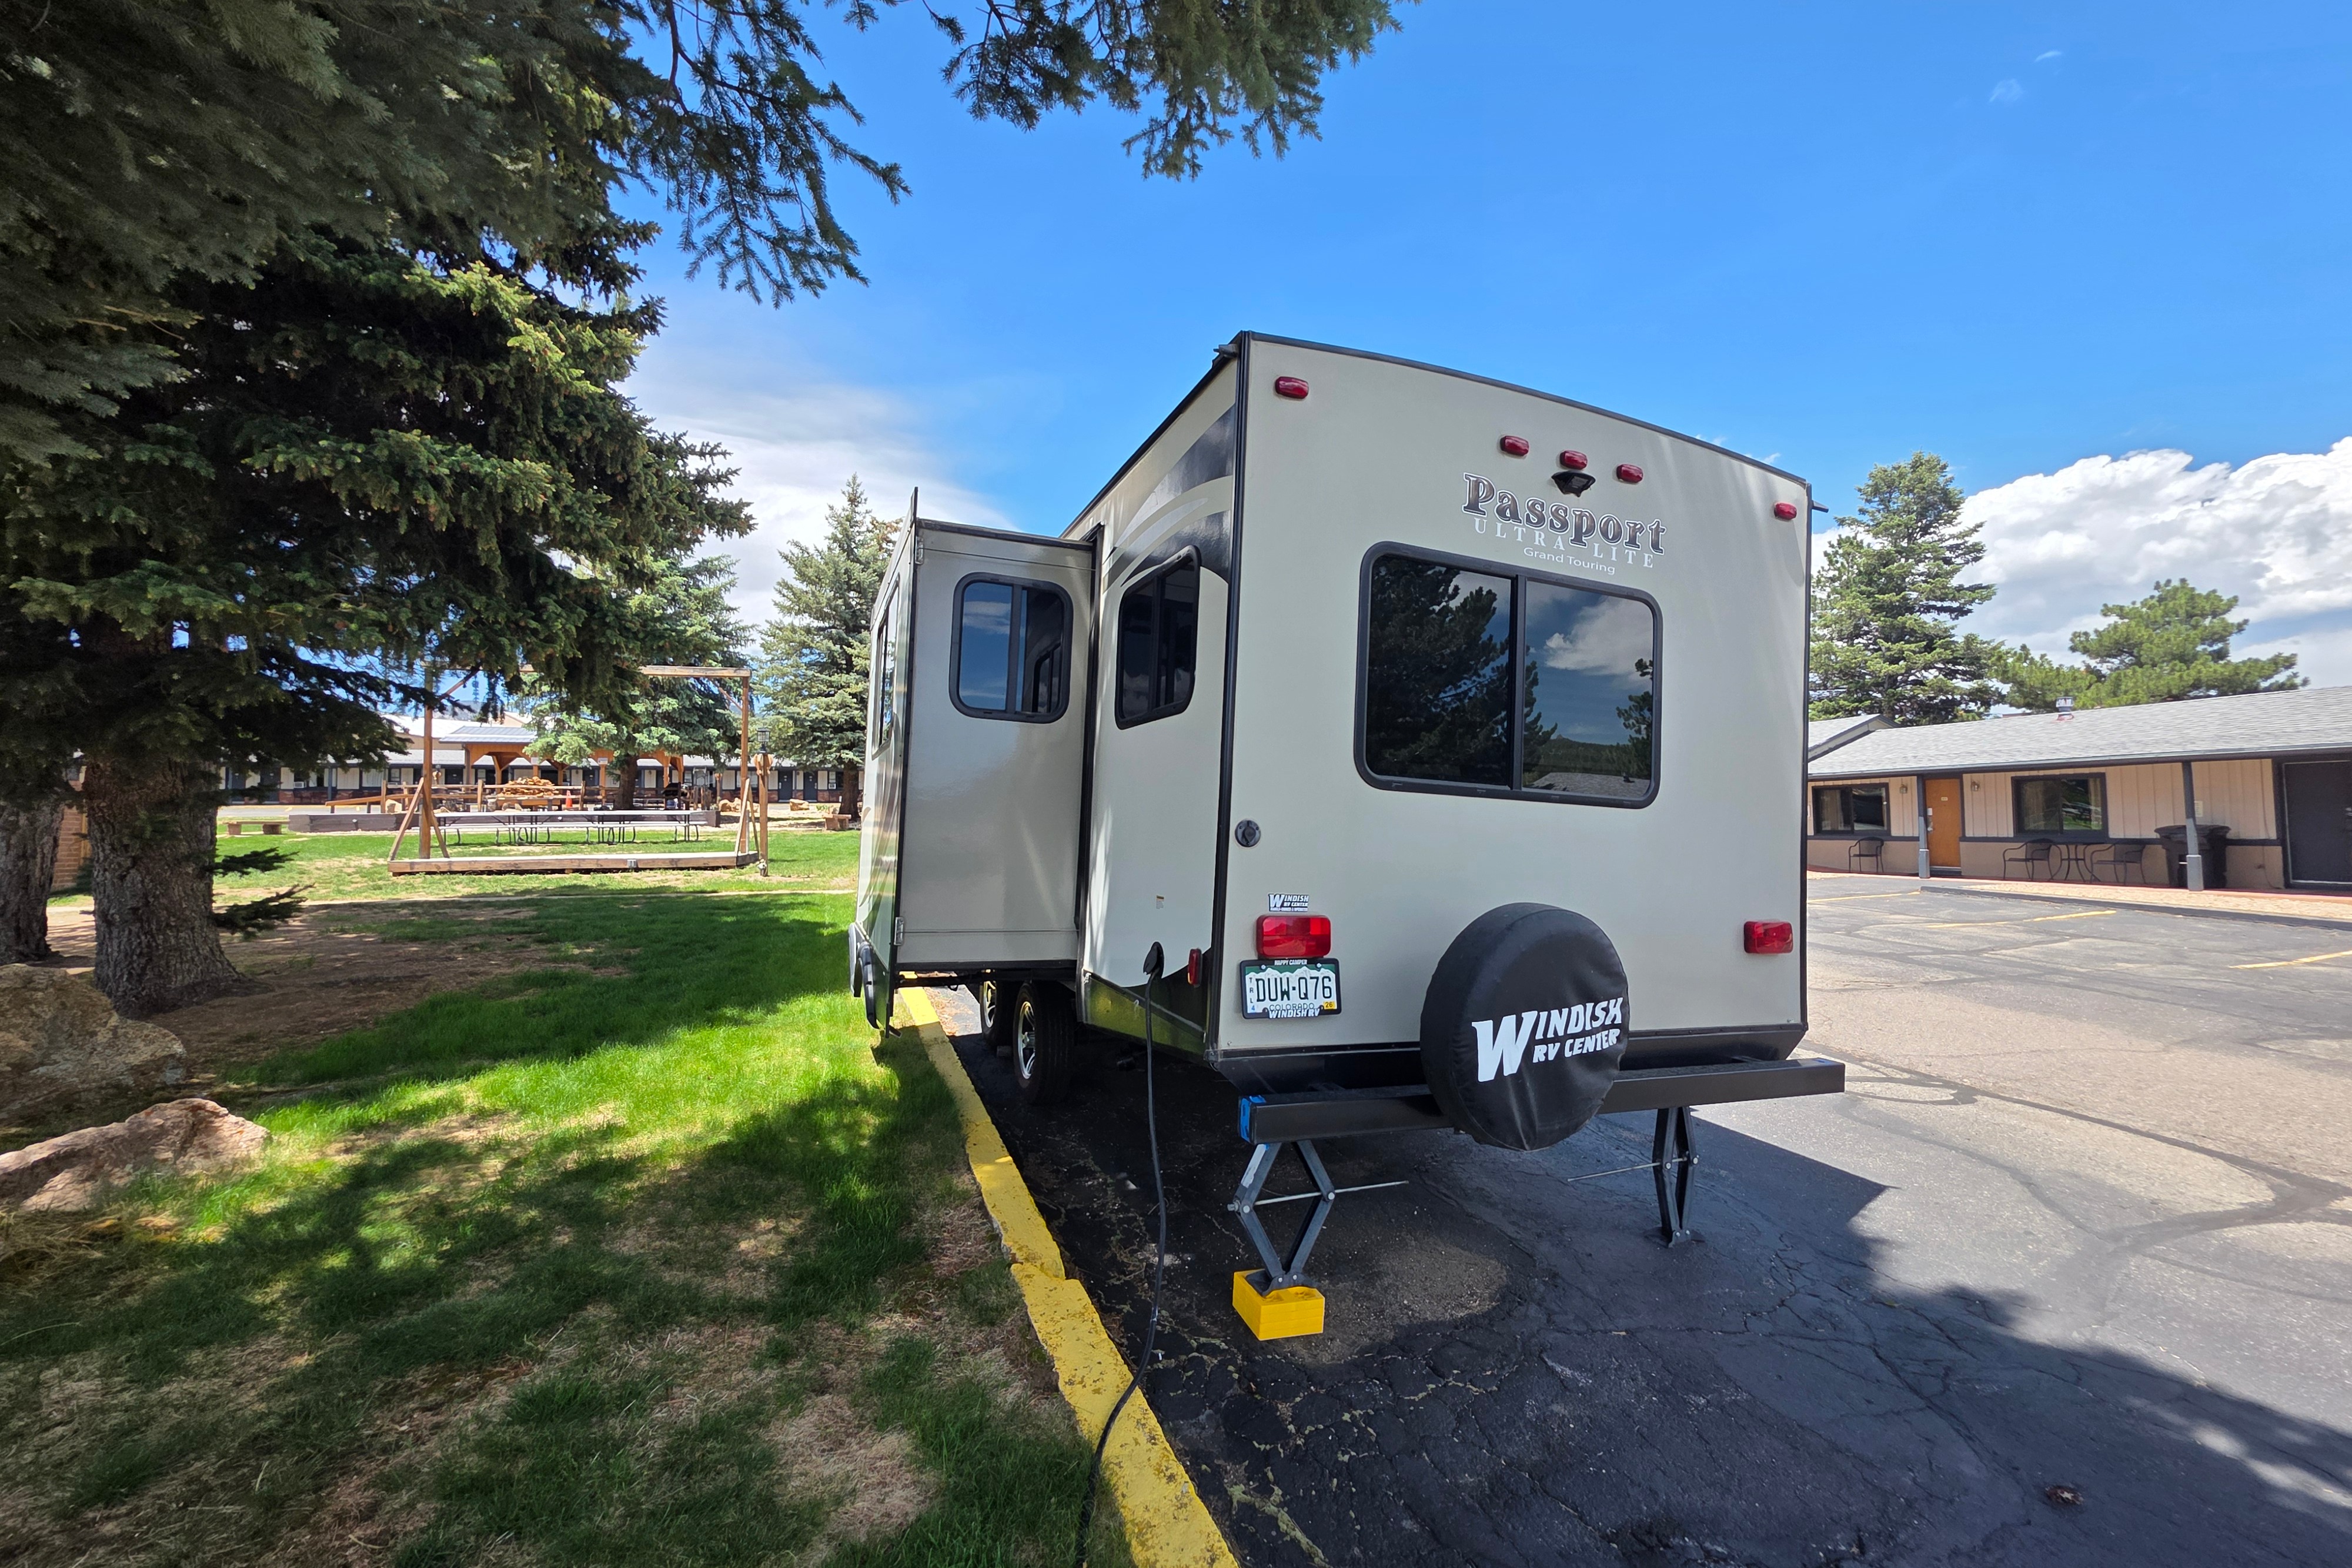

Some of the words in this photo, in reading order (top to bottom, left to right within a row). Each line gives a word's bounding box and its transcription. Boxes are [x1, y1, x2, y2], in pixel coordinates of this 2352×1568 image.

[1462, 473, 1666, 555] Passport
[1474, 517, 1565, 551] ULTRA
[1593, 542, 1653, 569] LITE
[1524, 547, 1563, 563] Grand
[1567, 556, 1616, 575] Touring
[1269, 894, 1309, 907] WINDISH
[1269, 1009, 1307, 1019] WINDISH
[1308, 1008, 1320, 1017] RV
[1472, 997, 1623, 1082] WINDISH
[1532, 1042, 1561, 1063] RV
[1564, 1028, 1621, 1058] CENTER
